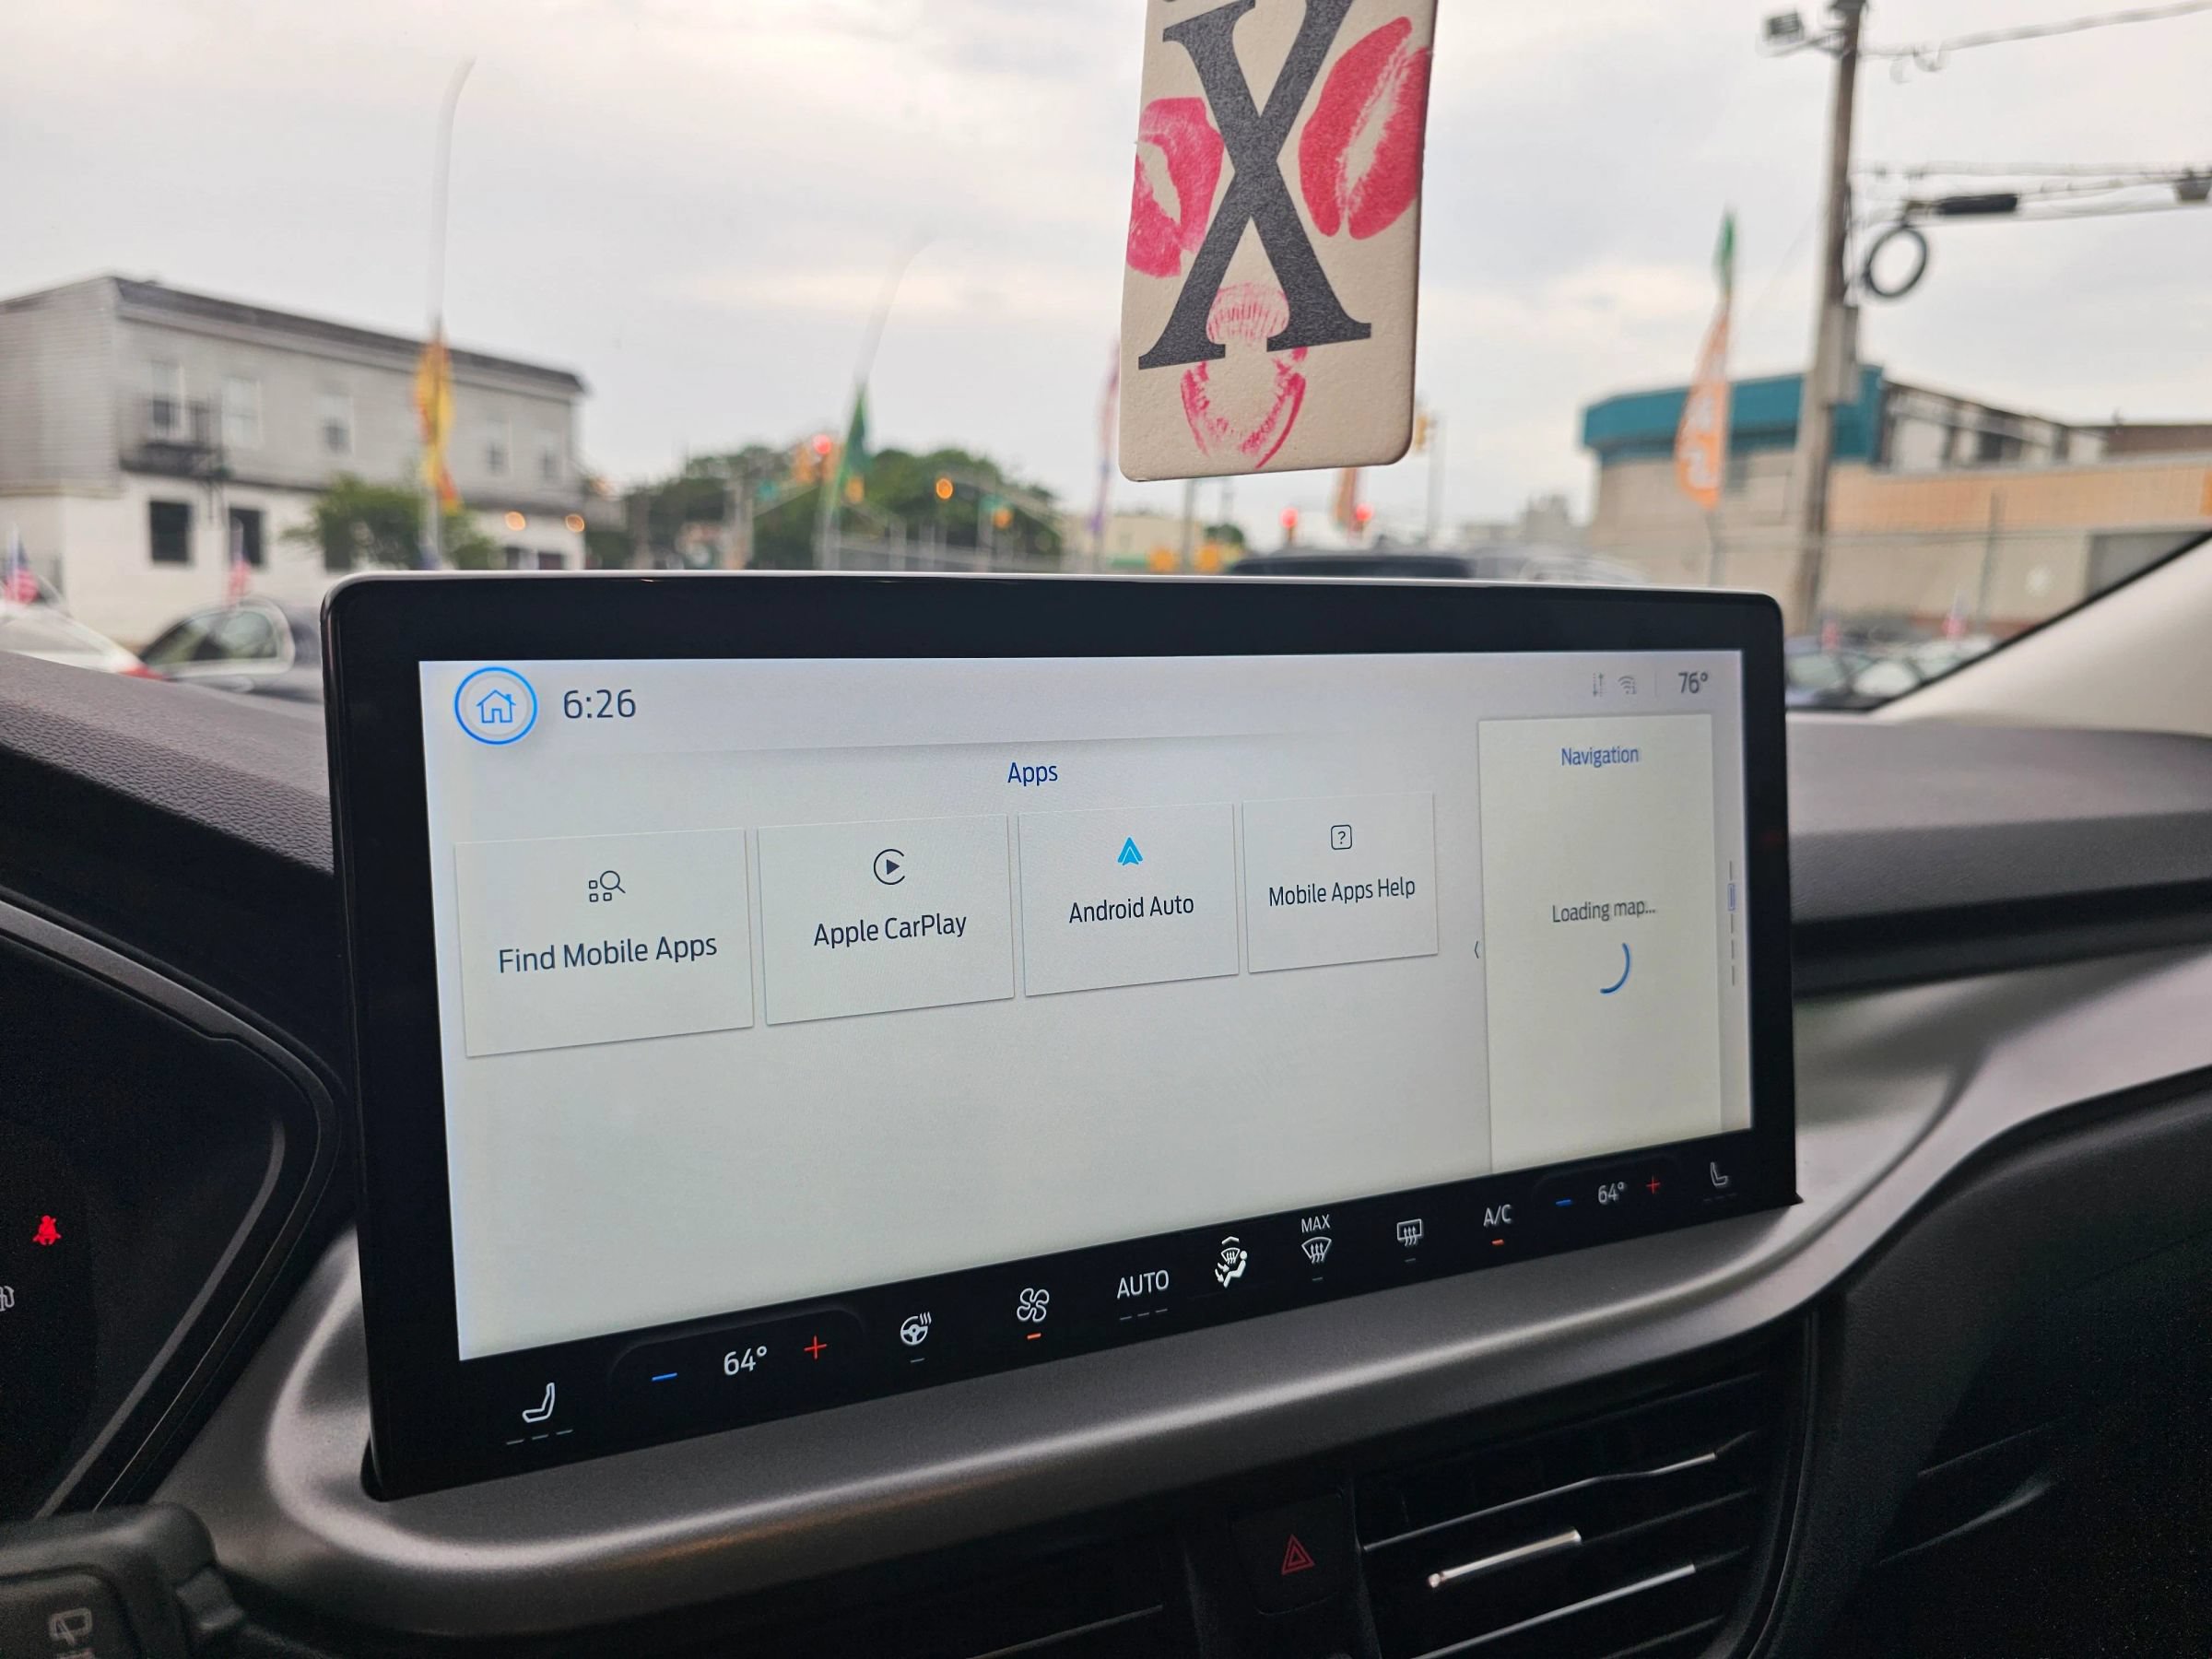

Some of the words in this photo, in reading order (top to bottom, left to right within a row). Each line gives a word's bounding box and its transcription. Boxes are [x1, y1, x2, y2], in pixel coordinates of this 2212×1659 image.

[1138, 0, 1371, 370] X
[564, 689, 636, 718] 6:26
[1562, 747, 1639, 768] Navigation
[1007, 762, 1057, 786] Apps
[1269, 884, 1326, 906] Mobile
[1332, 882, 1372, 904] Apps
[1378, 877, 1415, 899] Help
[1069, 897, 1144, 924] Android
[1150, 896, 1194, 916] Auto
[1553, 902, 1609, 923] Loading
[814, 920, 878, 948] Apple
[885, 913, 966, 939] CarPlay
[500, 945, 555, 973] Find
[564, 938, 648, 968] Mobile
[656, 936, 717, 962] Apps
[1301, 1214, 1330, 1232] MAX
[1484, 1205, 1511, 1226] A/C
[1117, 1270, 1169, 1299] AUTO
